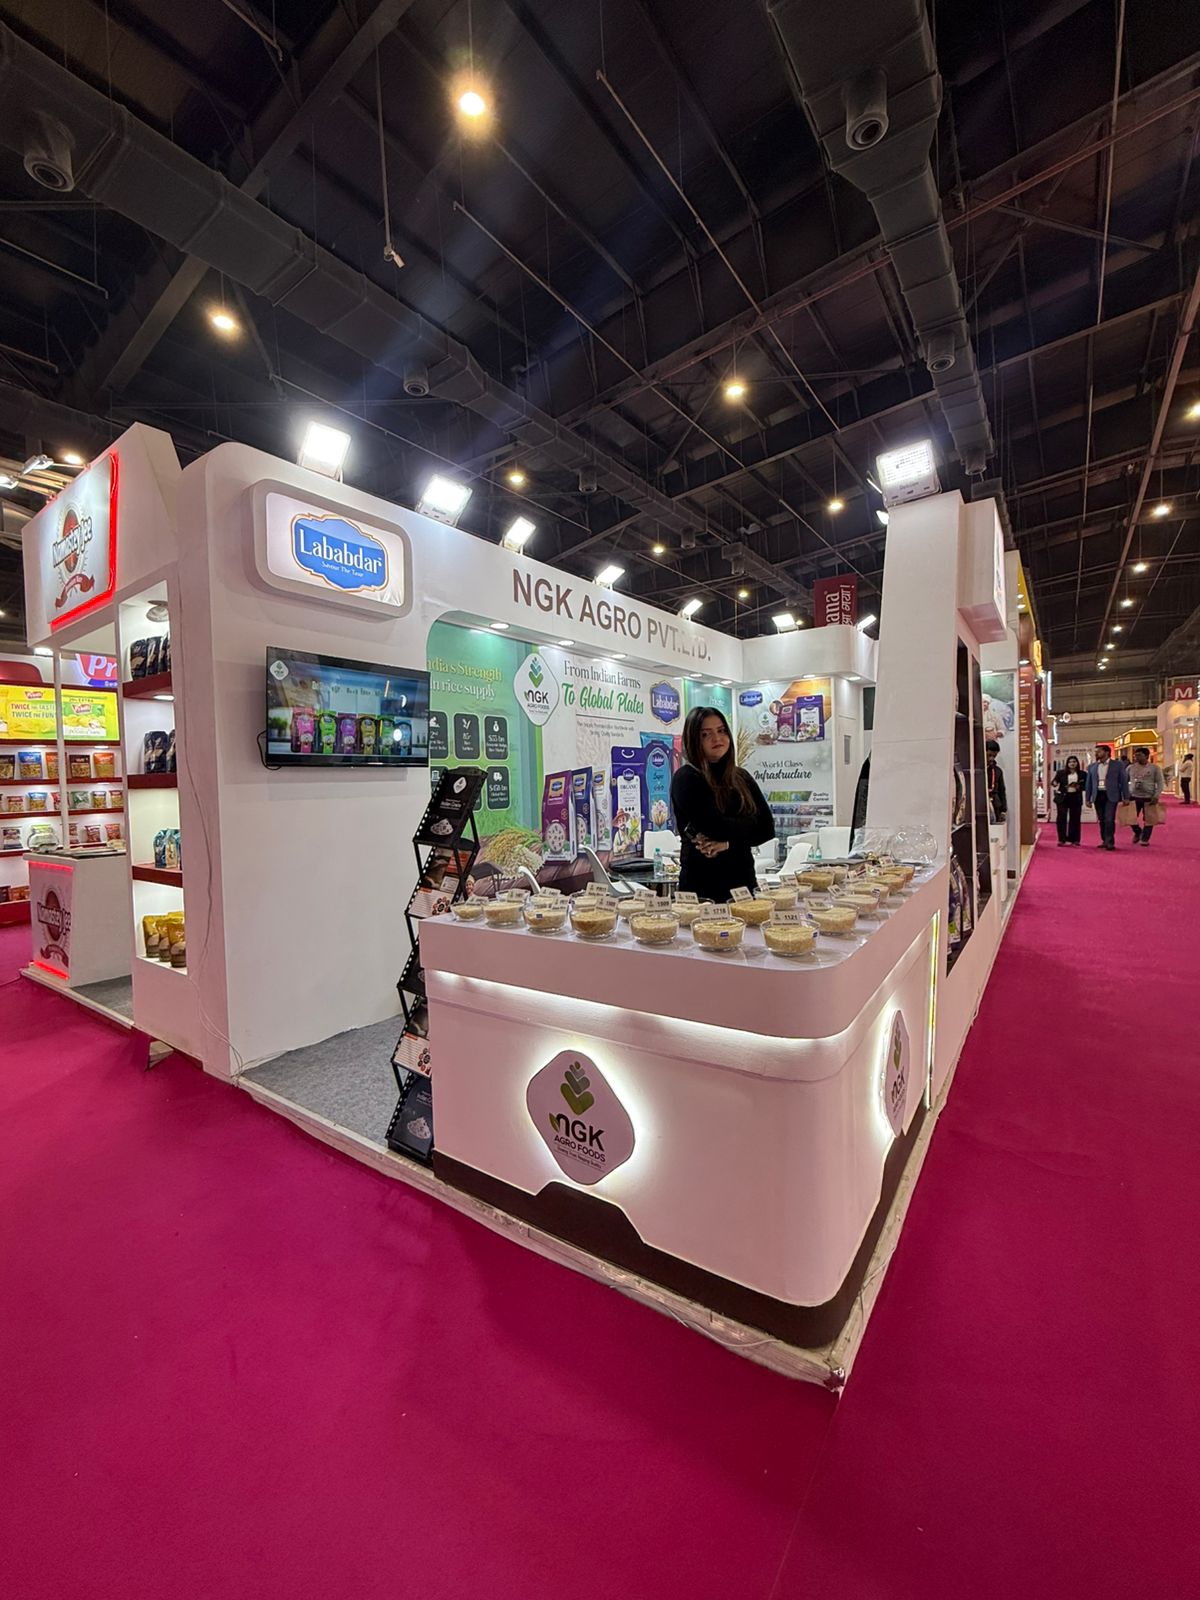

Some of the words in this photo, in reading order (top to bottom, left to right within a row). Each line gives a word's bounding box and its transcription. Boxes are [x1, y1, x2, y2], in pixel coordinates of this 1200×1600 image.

[300, 528, 382, 574] Lababdar
[513, 568, 574, 619] NGK
[579, 595, 642, 639] AGRO
[826, 591, 840, 625] ana
[88, 655, 117, 678] Pr
[564, 660, 590, 677] From
[591, 666, 617, 683] Indian
[617, 671, 641, 689] Farms
[441, 679, 463, 692] rice
[464, 684, 496, 700] supply
[562, 683, 575, 706] To
[580, 687, 614, 712] Global
[617, 692, 644, 714] Plates
[754, 768, 812, 783] Infrastructure
[762, 760, 783, 768] World
[784, 760, 803, 768] Class
[554, 1134, 576, 1149] AGRO
[577, 1144, 606, 1162] FOODS
